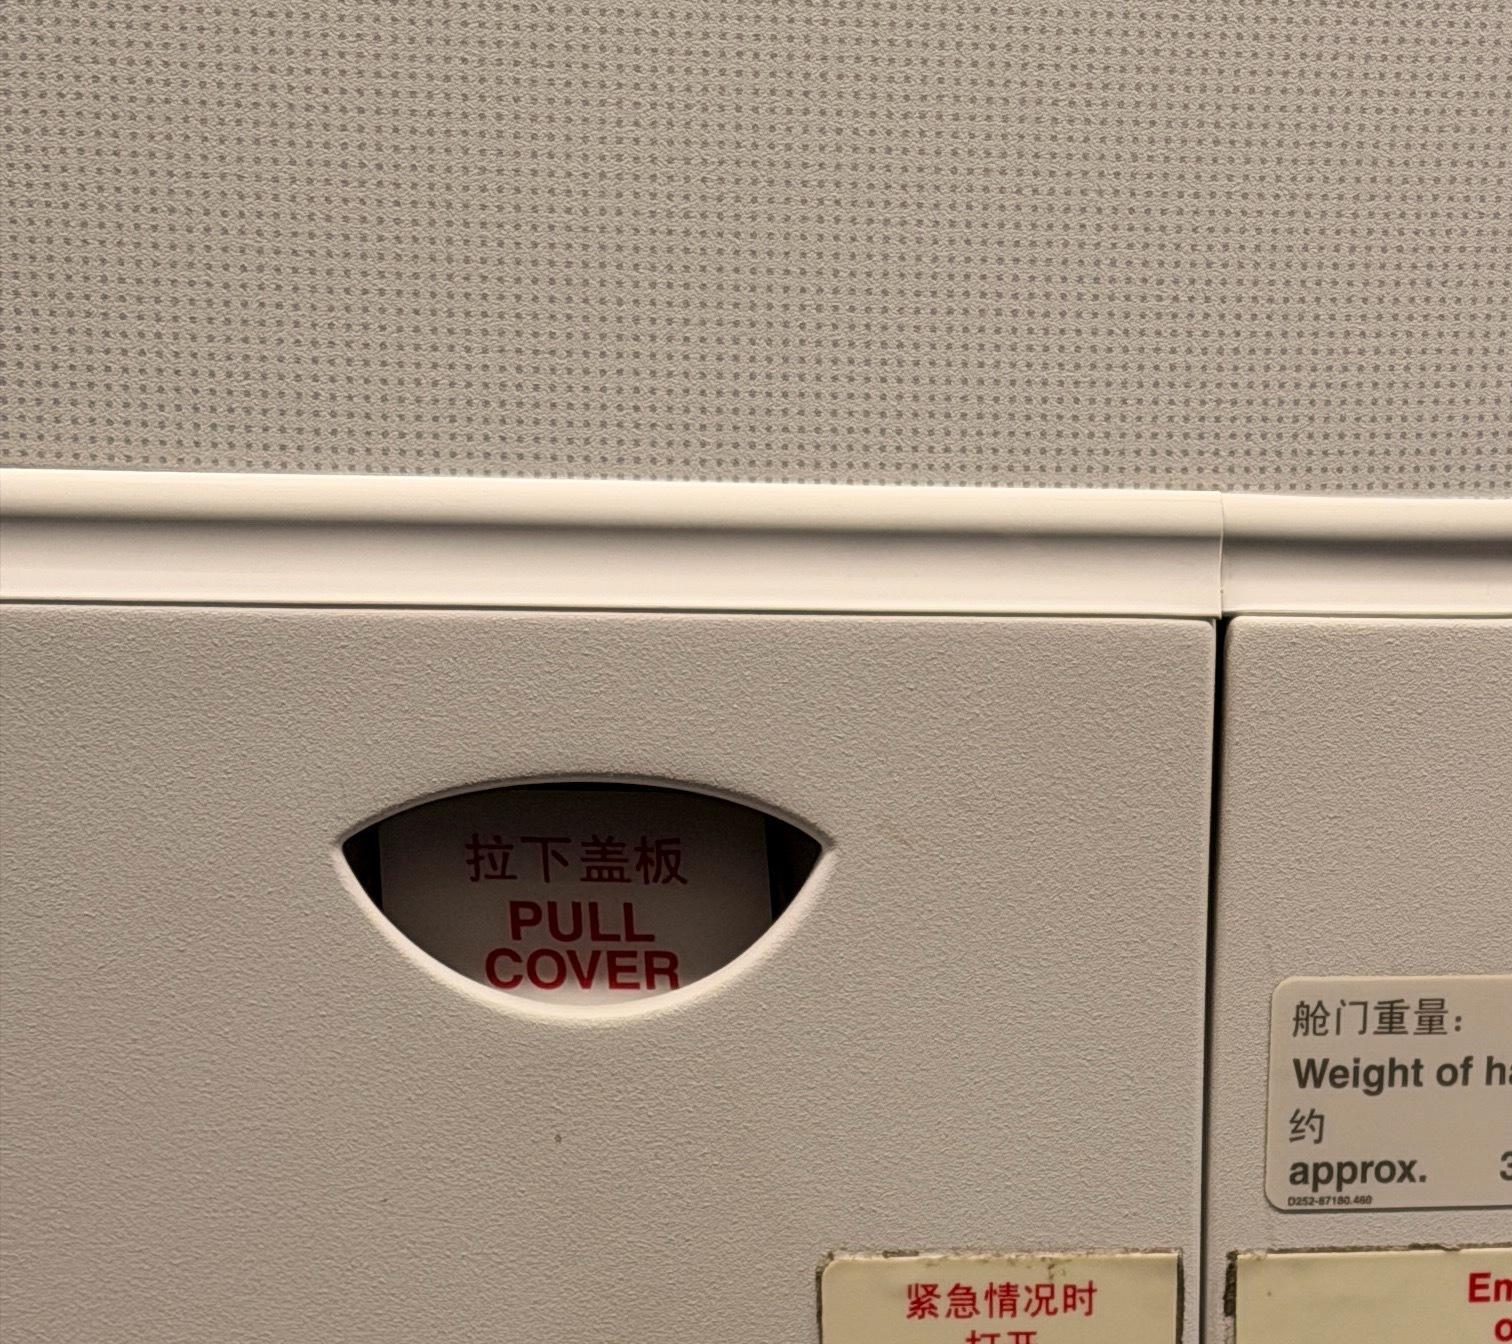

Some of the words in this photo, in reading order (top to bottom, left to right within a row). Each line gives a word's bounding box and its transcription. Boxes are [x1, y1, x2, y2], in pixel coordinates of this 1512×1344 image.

[465, 832, 688, 885] 拉下盖板
[508, 901, 656, 943] PULL
[484, 948, 680, 991] COVER
[1292, 1056, 1425, 1097] Weight
[1436, 1055, 1474, 1087] of
[1288, 1108, 1326, 1145] 约
[1288, 1158, 1427, 1194] approx.
[905, 1281, 1098, 1319] 紧急情况时
